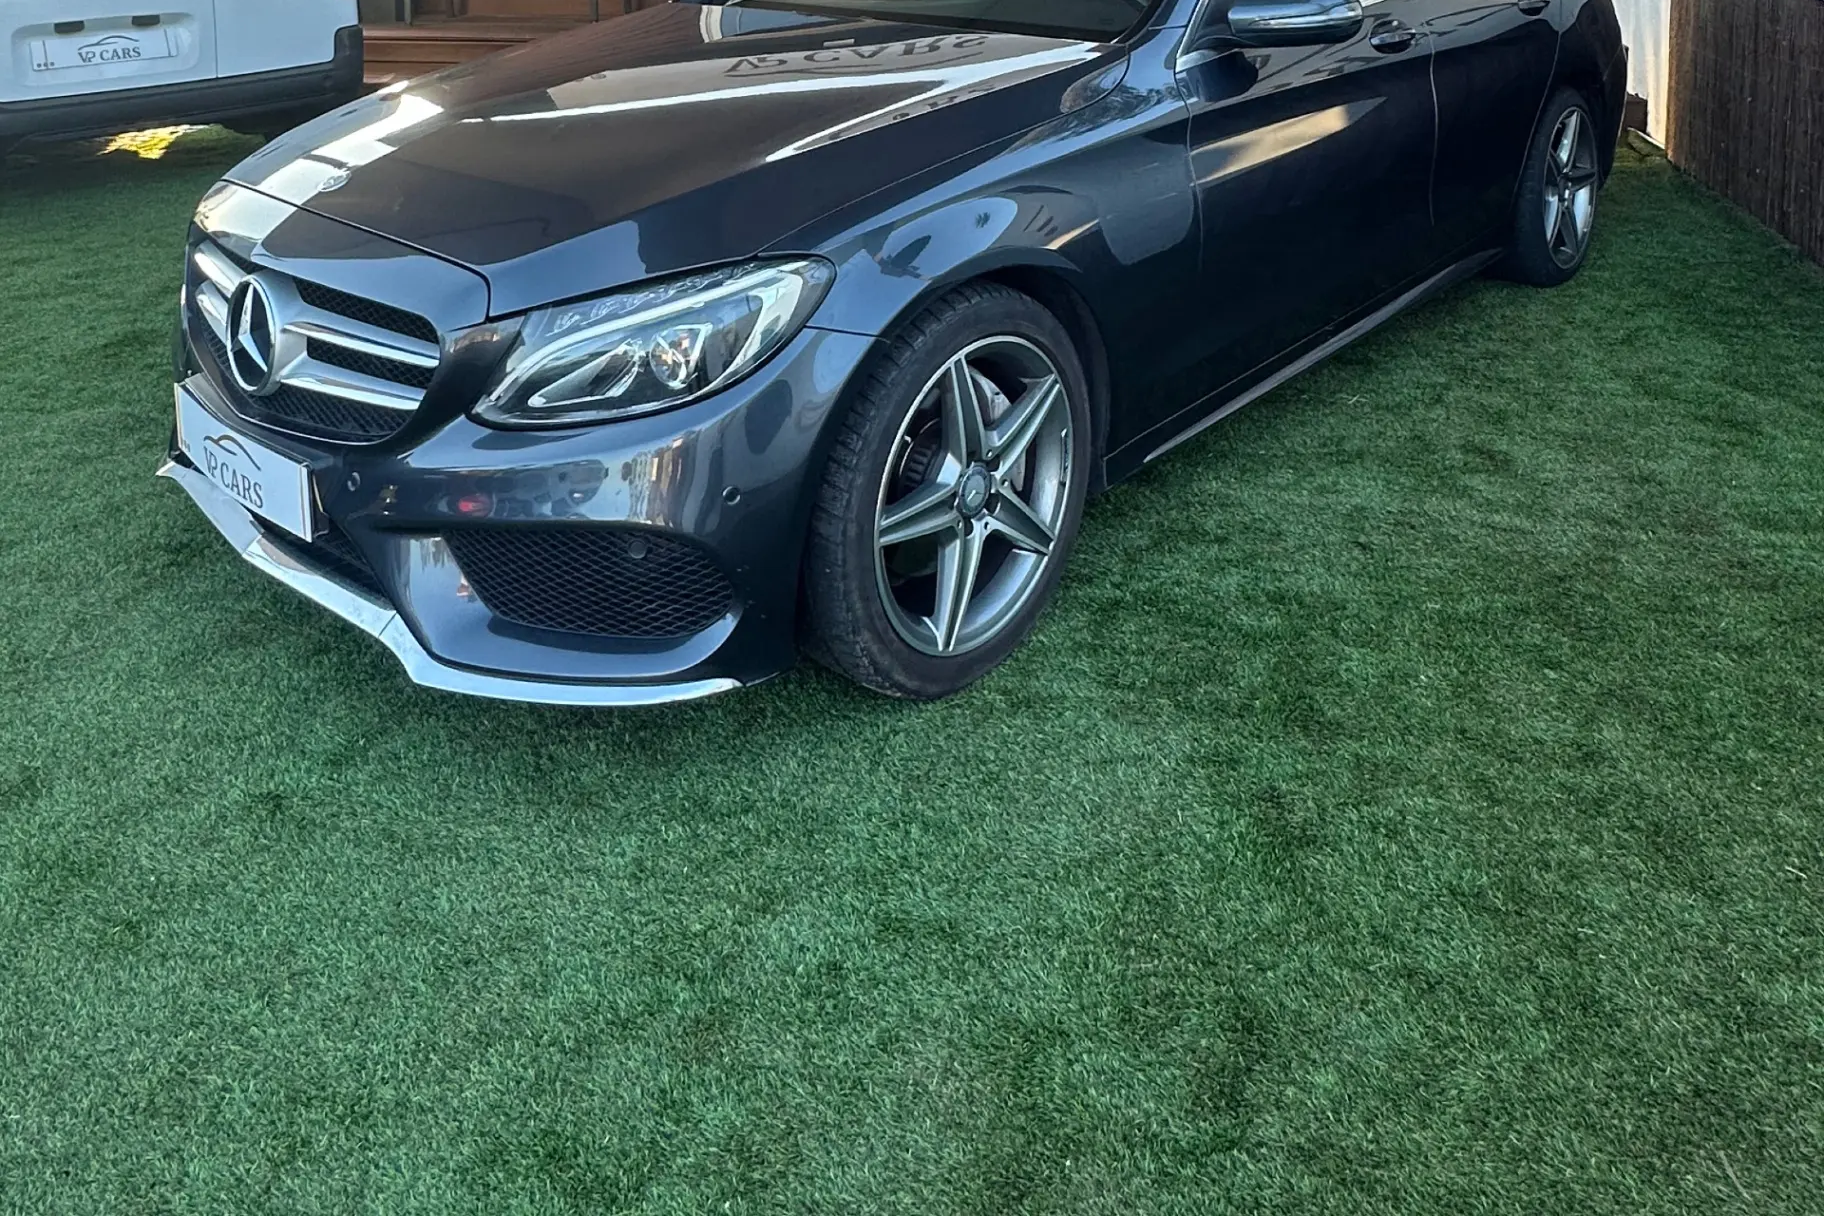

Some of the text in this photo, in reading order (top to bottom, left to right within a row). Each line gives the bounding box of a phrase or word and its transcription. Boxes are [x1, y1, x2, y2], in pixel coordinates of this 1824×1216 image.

[77, 46, 142, 64] VP CARS
[203, 445, 264, 509] VP CARS
